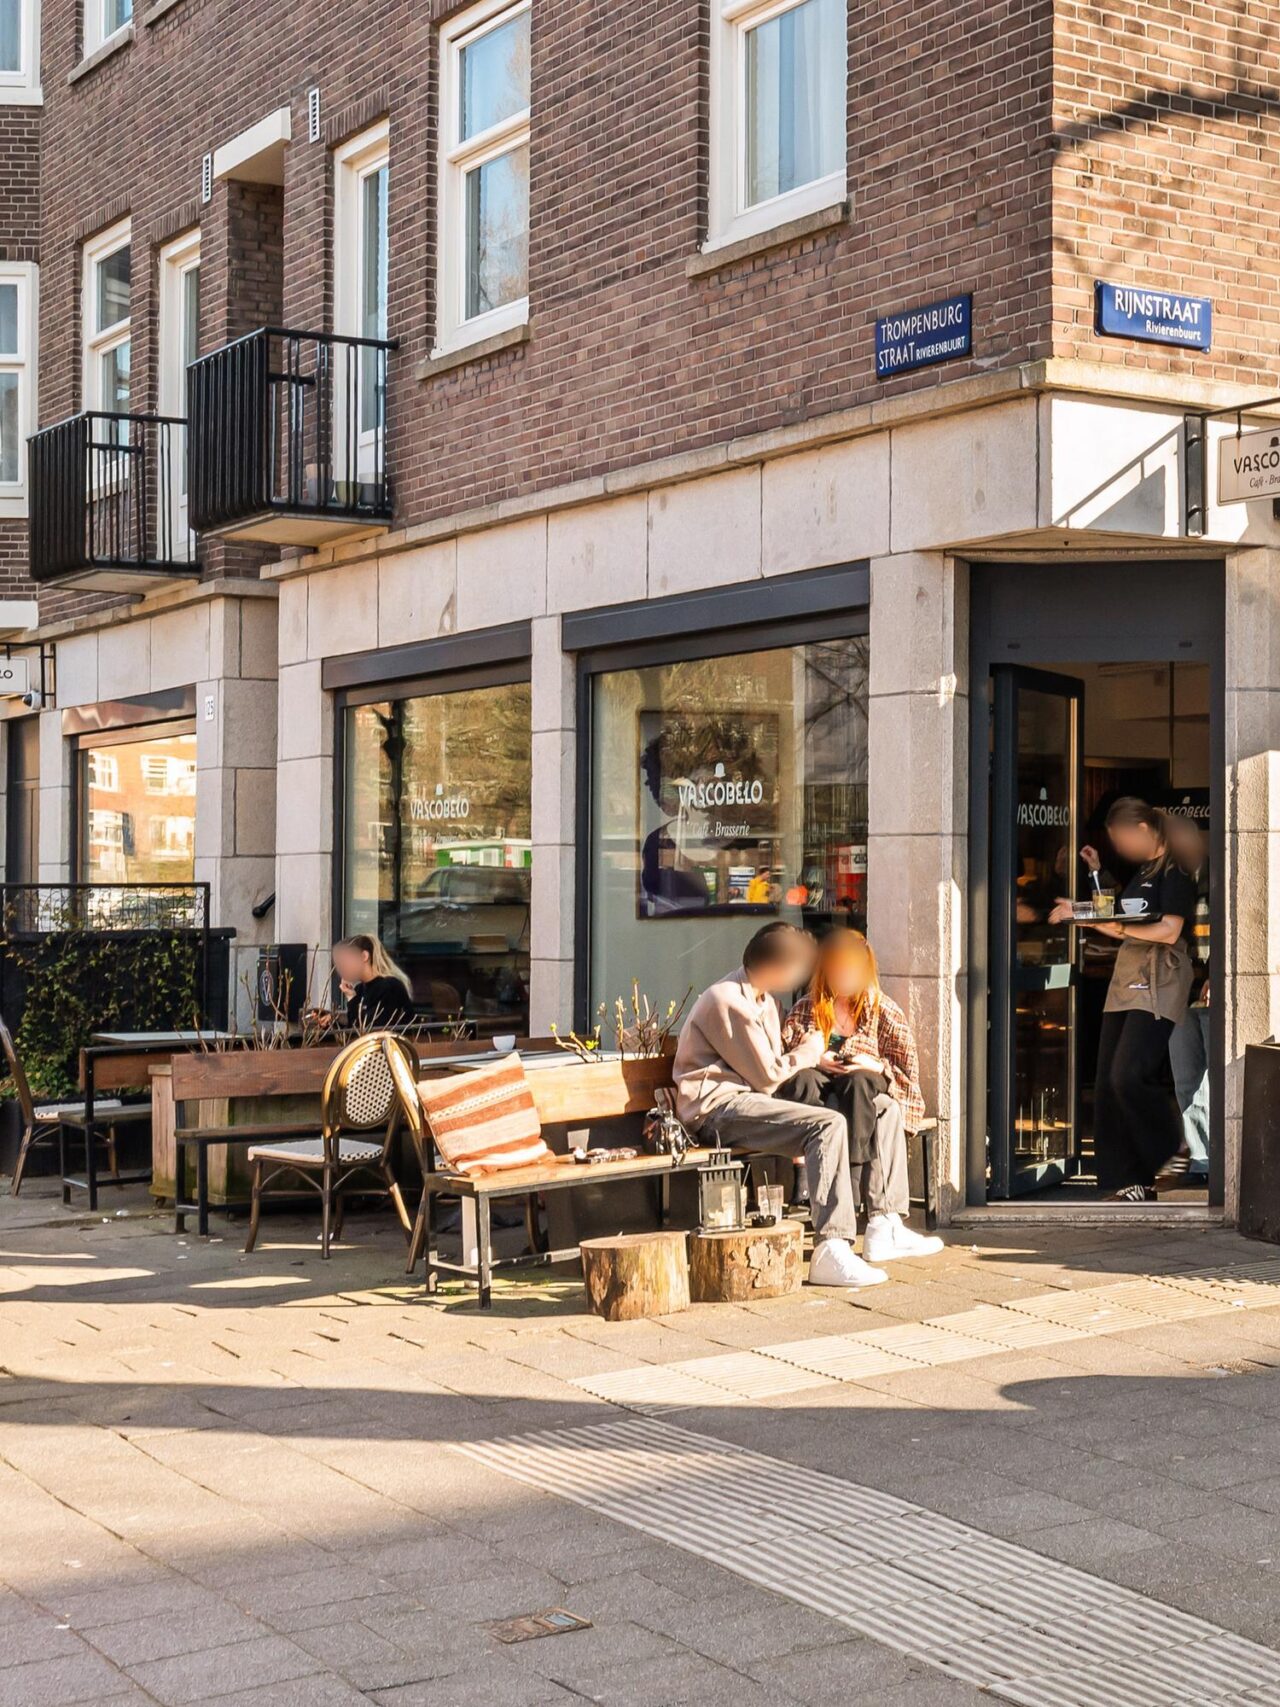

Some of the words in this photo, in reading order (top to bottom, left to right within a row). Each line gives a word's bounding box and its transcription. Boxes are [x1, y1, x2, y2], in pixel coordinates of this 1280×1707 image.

[1115, 289, 1202, 324] RIJNSTRAAT
[881, 304, 963, 343] TROMPENBURG
[1146, 319, 1202, 341] Rivierenbuurt
[879, 342, 915, 370] STRAAT
[916, 336, 966, 361] RIVIERENBUURT
[1249, 476, 1264, 489] Café
[678, 780, 763, 808] VASCOBELO
[410, 798, 469, 821] VASCOBELO
[714, 820, 751, 838] Brasserie
